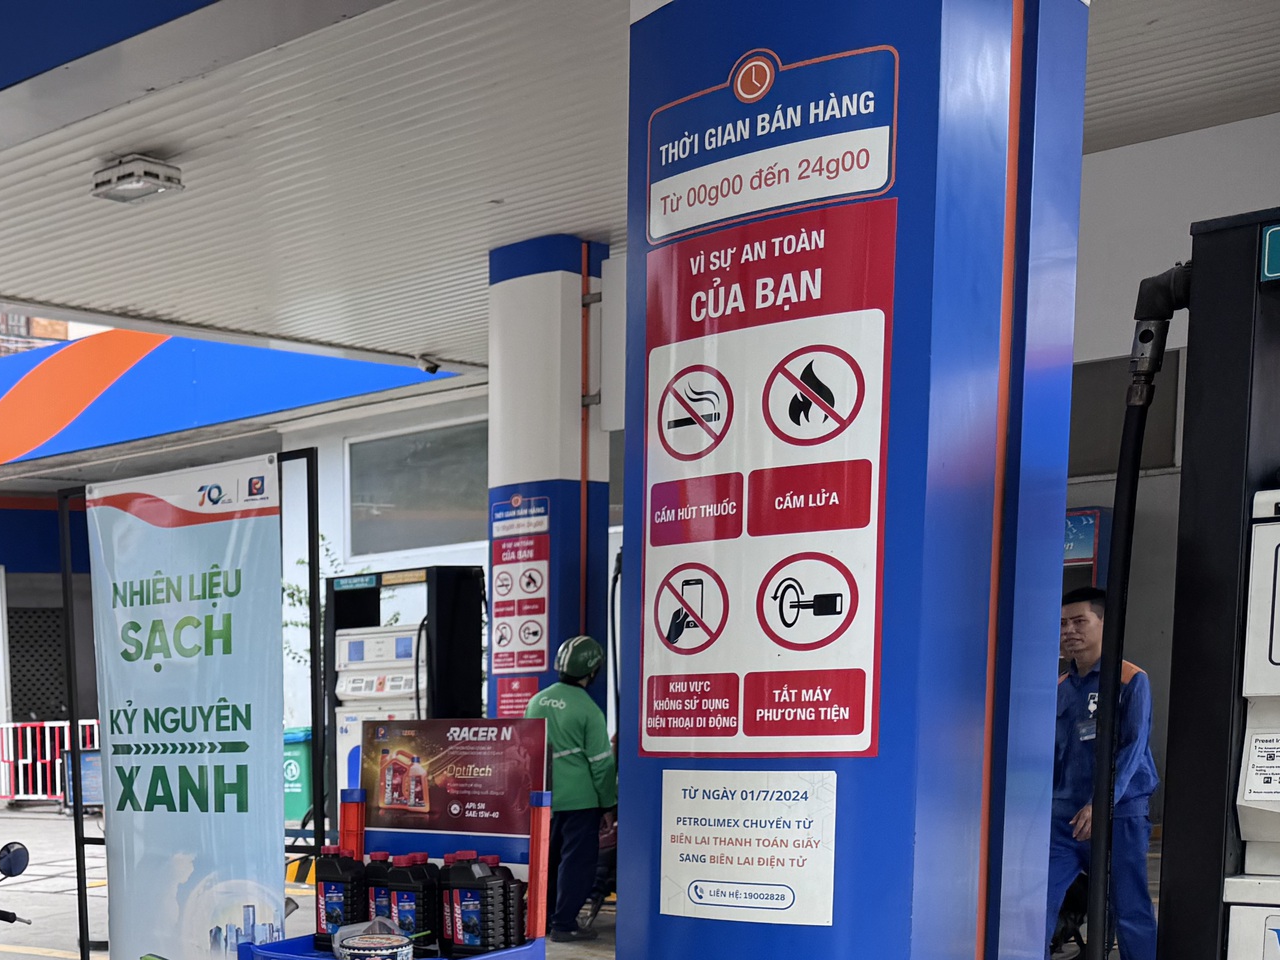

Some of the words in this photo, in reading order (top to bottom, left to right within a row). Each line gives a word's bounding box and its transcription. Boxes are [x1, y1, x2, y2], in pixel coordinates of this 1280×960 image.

[659, 133, 698, 166] THỜI
[704, 118, 750, 151] GIAN
[757, 105, 801, 136] BÁN
[809, 91, 875, 124] HÀNG
[660, 192, 682, 216] Từ
[687, 174, 743, 208] 00g00
[750, 162, 789, 190] đến
[797, 148, 870, 181] 24g00
[690, 251, 704, 276] VÌ
[710, 247, 736, 271] SỰ
[741, 239, 766, 263] AN
[771, 228, 825, 257] TOÀN
[690, 278, 745, 323] CỦA
[755, 268, 822, 311] BẠN
[775, 490, 804, 510] CẤM
[808, 489, 839, 507] LỬA
[655, 505, 675, 523] CẤM
[678, 506, 697, 520] HÚT
[700, 498, 736, 517] THUỐC
[112, 569, 182, 608] NHIÊN
[189, 563, 242, 608] LIỆU
[119, 613, 233, 673] SẠCH
[669, 681, 687, 693] KHU
[689, 680, 710, 694] VỰC
[773, 684, 797, 703] TẮT
[801, 686, 832, 701] MÁY
[539, 696, 566, 710] Grab
[654, 697, 682, 710] KHÔNG
[684, 696, 699, 710] SỬ
[702, 698, 729, 712] DỤNG
[756, 707, 815, 721] PHƯƠNG
[819, 703, 849, 721] TIỆN
[110, 700, 137, 735] KỶ
[144, 697, 252, 735] NGUYÊN
[647, 715, 666, 730] ĐIỆN
[668, 715, 693, 730] THOẠI
[696, 717, 706, 728] DI
[709, 714, 736, 730] ĐỘNG
[447, 727, 497, 741] RACER
[501, 727, 512, 741] N
[115, 764, 249, 813] XANH
[682, 786, 699, 800] TỪ
[702, 785, 737, 800] NGÀY
[740, 789, 809, 801] 01/7/2024
[676, 817, 740, 828] PETROLIMEX
[743, 816, 791, 829] CHUYỂN
[795, 817, 814, 830] TỪ
[670, 833, 692, 844] BIÊN
[695, 836, 710, 845] LAI
[713, 837, 752, 847] THANH
[755, 836, 789, 848] TOÁN
[793, 837, 821, 849] GIẤY
[679, 853, 706, 863] SANG
[710, 854, 734, 865] BIÊN
[737, 855, 754, 866] LAI
[757, 855, 785, 869] ĐIỆN
[789, 855, 807, 868] TỬ
[709, 888, 726, 897] LIÊN
[743, 892, 786, 901] 19002828
[454, 904, 463, 940] scooter
